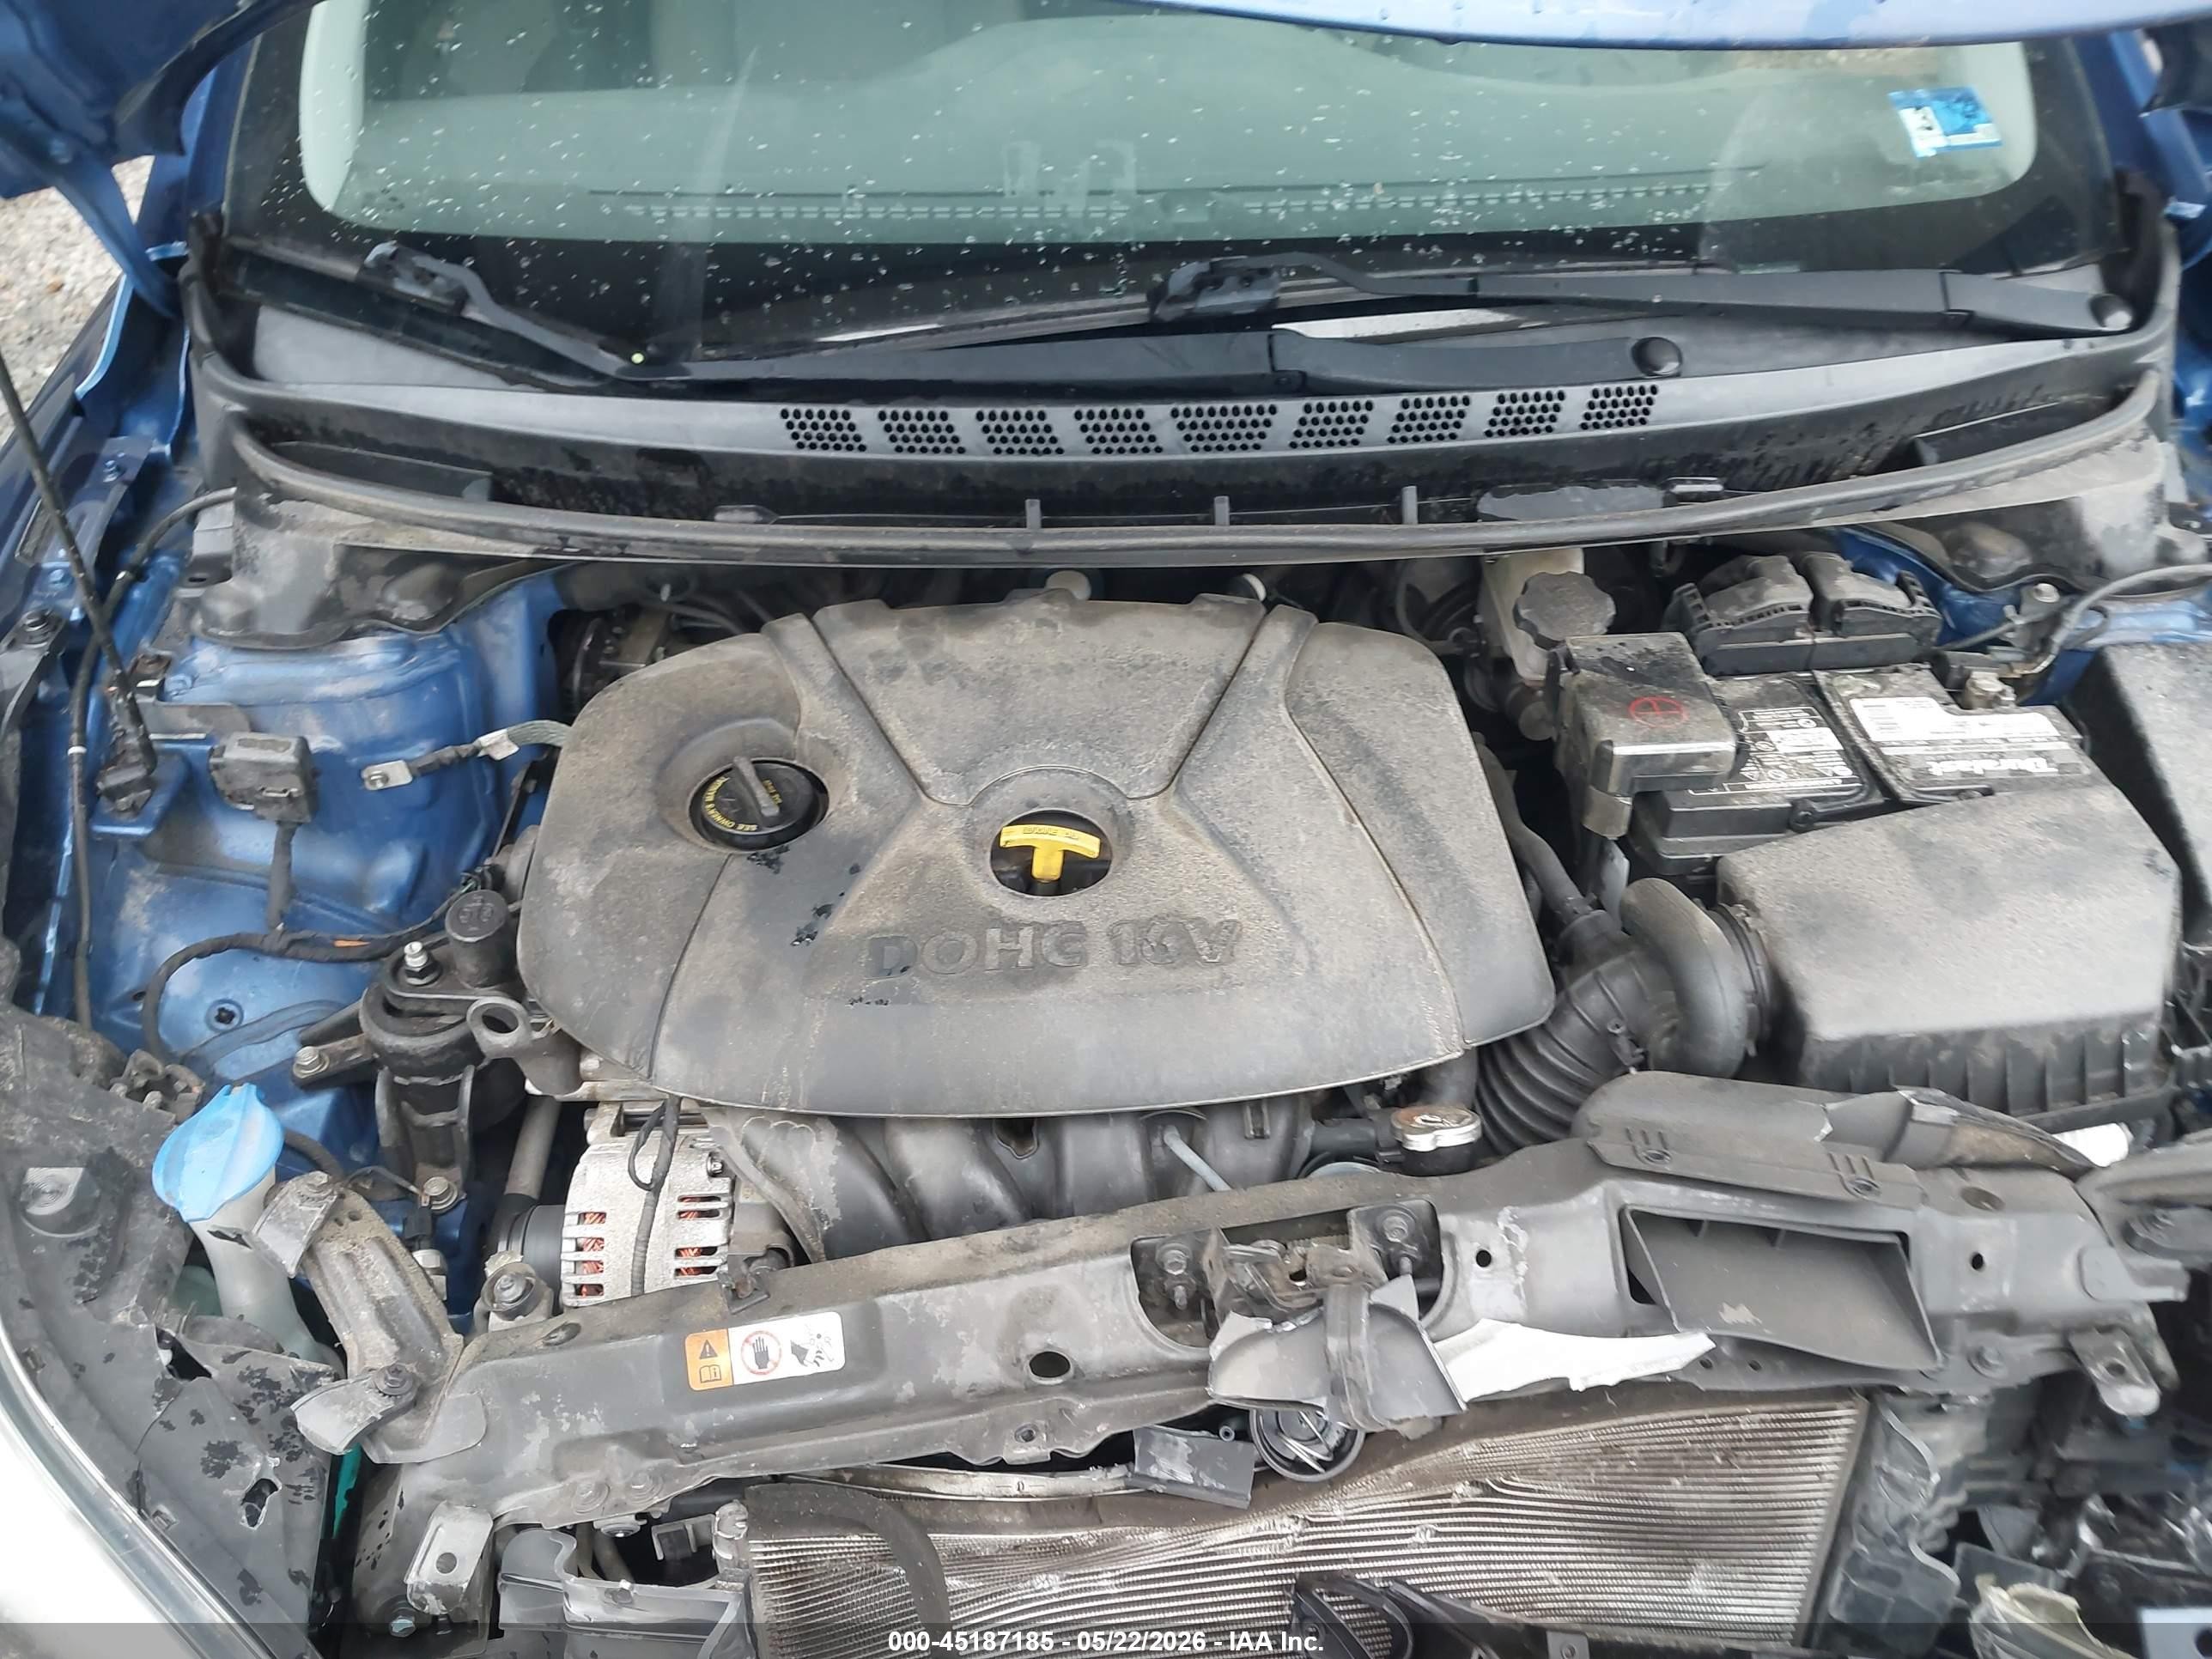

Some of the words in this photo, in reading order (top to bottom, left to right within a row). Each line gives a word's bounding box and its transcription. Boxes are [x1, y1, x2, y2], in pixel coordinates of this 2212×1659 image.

[1925, 757, 2058, 776] Duralast
[862, 919, 1089, 980] DOHC
[1110, 918, 1243, 967] 16V
